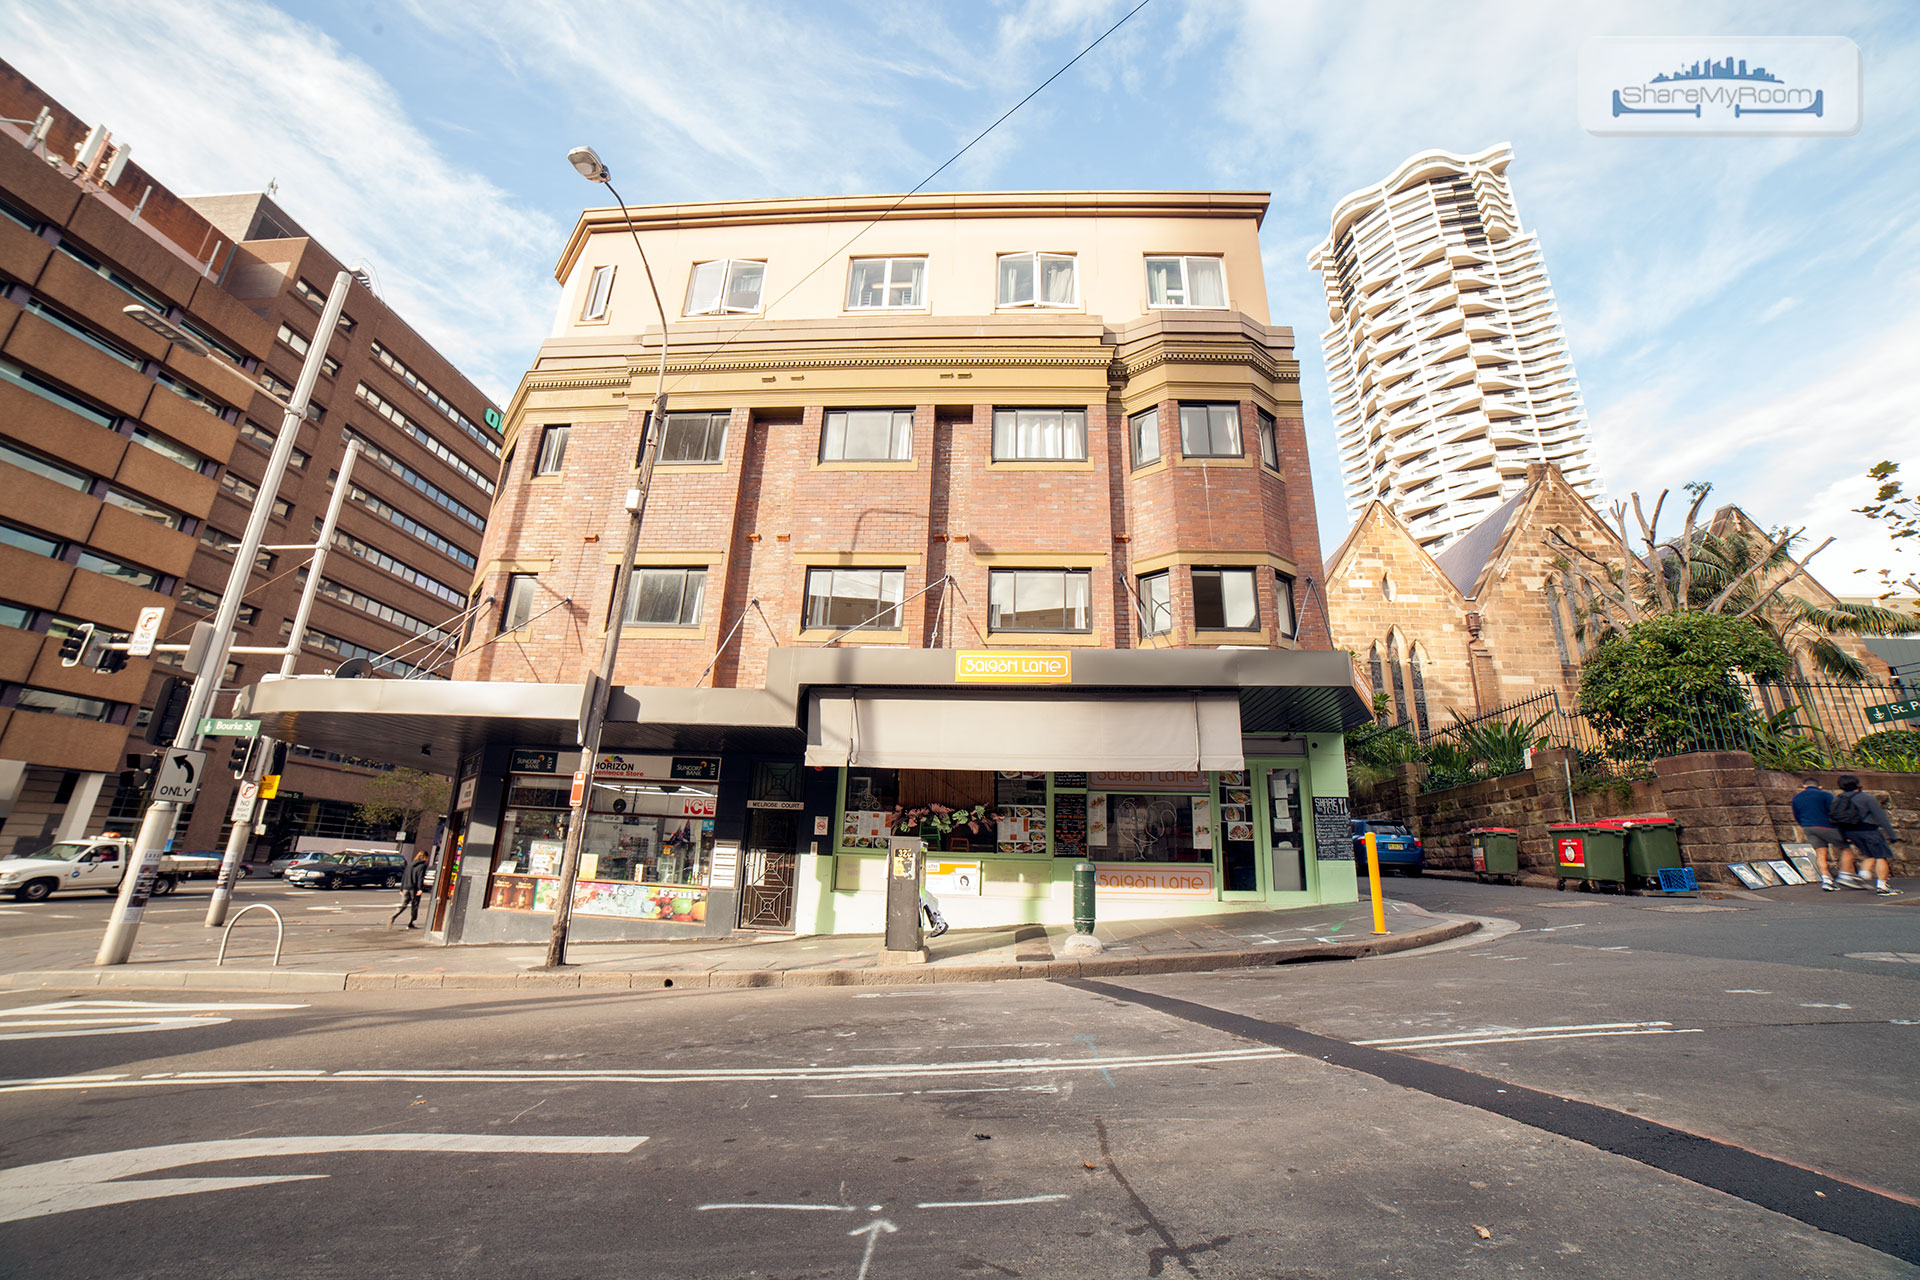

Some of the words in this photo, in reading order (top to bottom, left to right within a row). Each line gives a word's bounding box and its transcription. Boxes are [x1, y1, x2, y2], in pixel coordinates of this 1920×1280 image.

[215, 720, 243, 731] Bourke
[244, 721, 253, 731] St
[595, 762, 635, 771] HORIZON
[594, 769, 624, 777] venience
[160, 785, 192, 797] ONLY
[683, 798, 716, 815] ICE
[612, 885, 635, 896] Ice
[659, 888, 702, 900] Fruit
